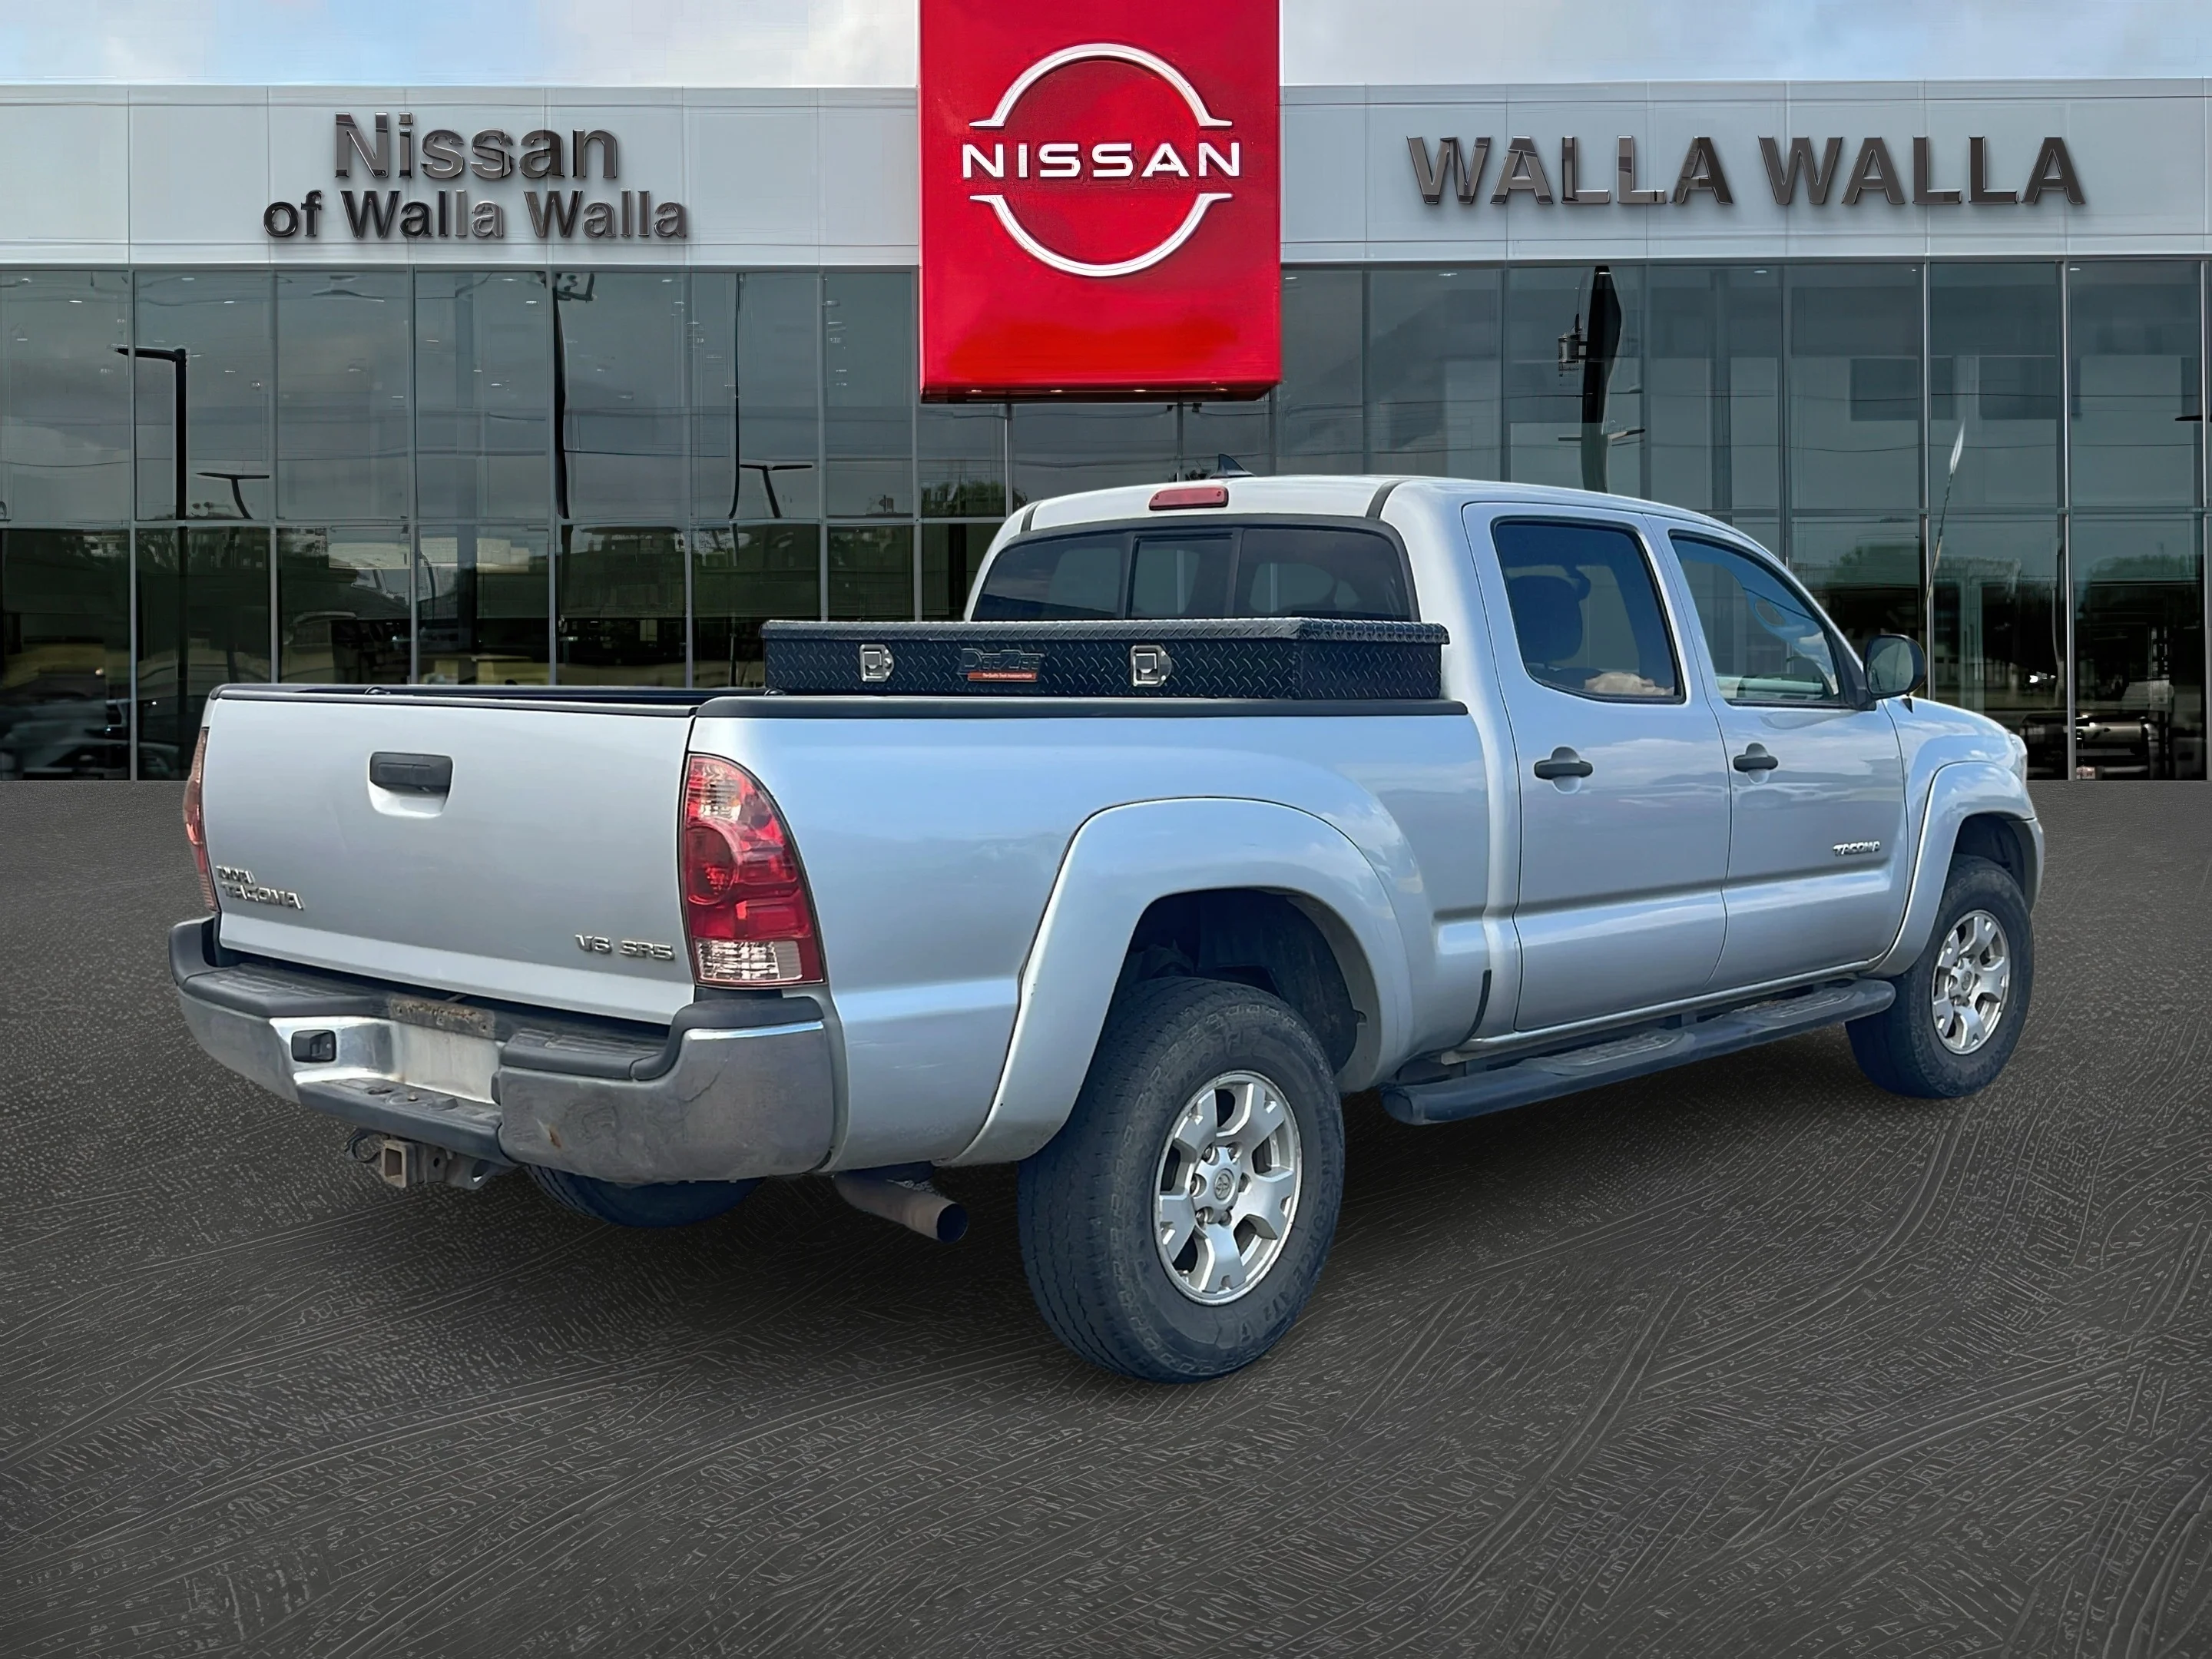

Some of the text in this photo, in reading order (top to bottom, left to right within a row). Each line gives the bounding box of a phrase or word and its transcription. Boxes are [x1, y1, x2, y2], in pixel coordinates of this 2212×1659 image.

[333, 111, 618, 179] Nissan
[962, 142, 1241, 180] NISSAN
[1406, 135, 2086, 205] WALLA WALLA
[263, 189, 687, 239] of Walla Walla
[1833, 840, 1880, 856] TACOMA
[220, 881, 305, 910] TACOMA
[575, 934, 676, 961] V6 SR5
